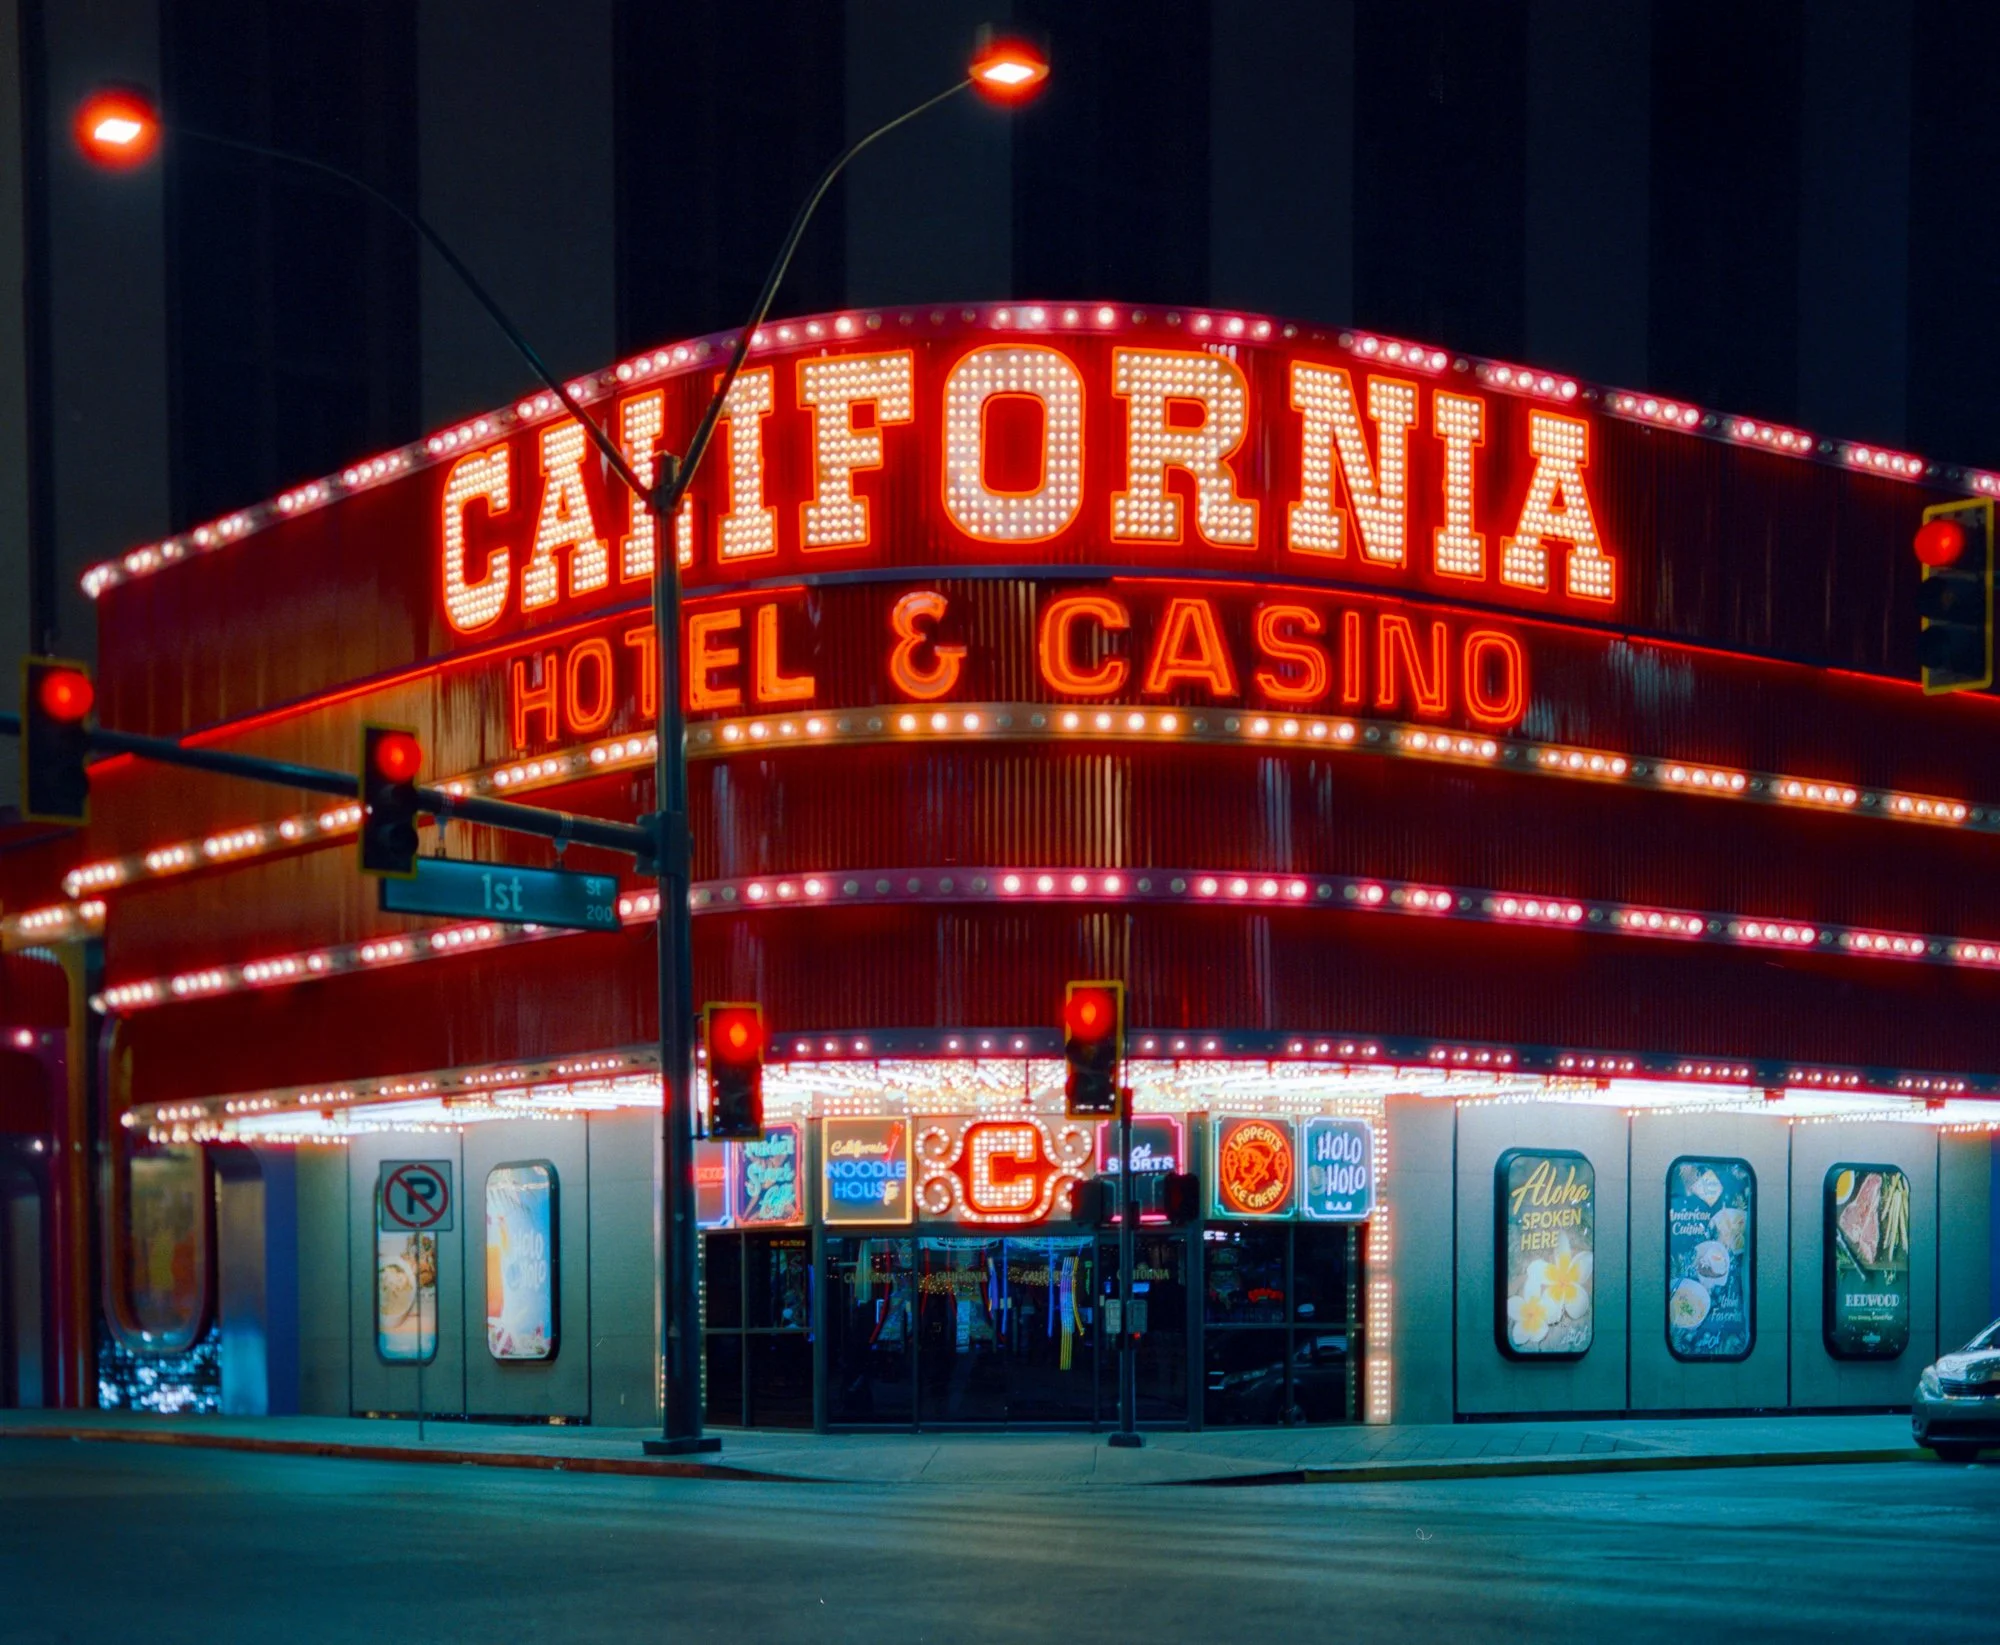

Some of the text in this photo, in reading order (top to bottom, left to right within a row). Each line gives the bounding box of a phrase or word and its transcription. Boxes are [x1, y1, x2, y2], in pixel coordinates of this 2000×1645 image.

[442, 342, 1617, 634] CALIFORNIA
[512, 590, 1530, 750] HOTEL & CASINO
[481, 872, 601, 913] 1st St
[586, 904, 613, 923] 200
[831, 1140, 888, 1158] California
[1318, 1131, 1363, 1164] HOLO
[826, 1160, 907, 1180] NOODLE
[972, 1125, 1037, 1212] C
[1107, 1156, 1175, 1174] SORTS
[833, 1180, 900, 1205] HOUSE
[1326, 1163, 1367, 1197] HOLO
[1512, 1159, 1591, 1216] Aloha
[1230, 1181, 1284, 1208] ICE CREAM
[1522, 1208, 1582, 1230] SPOKEN
[1520, 1230, 1559, 1251] HERE
[1844, 1293, 1900, 1307] REDWOOD
